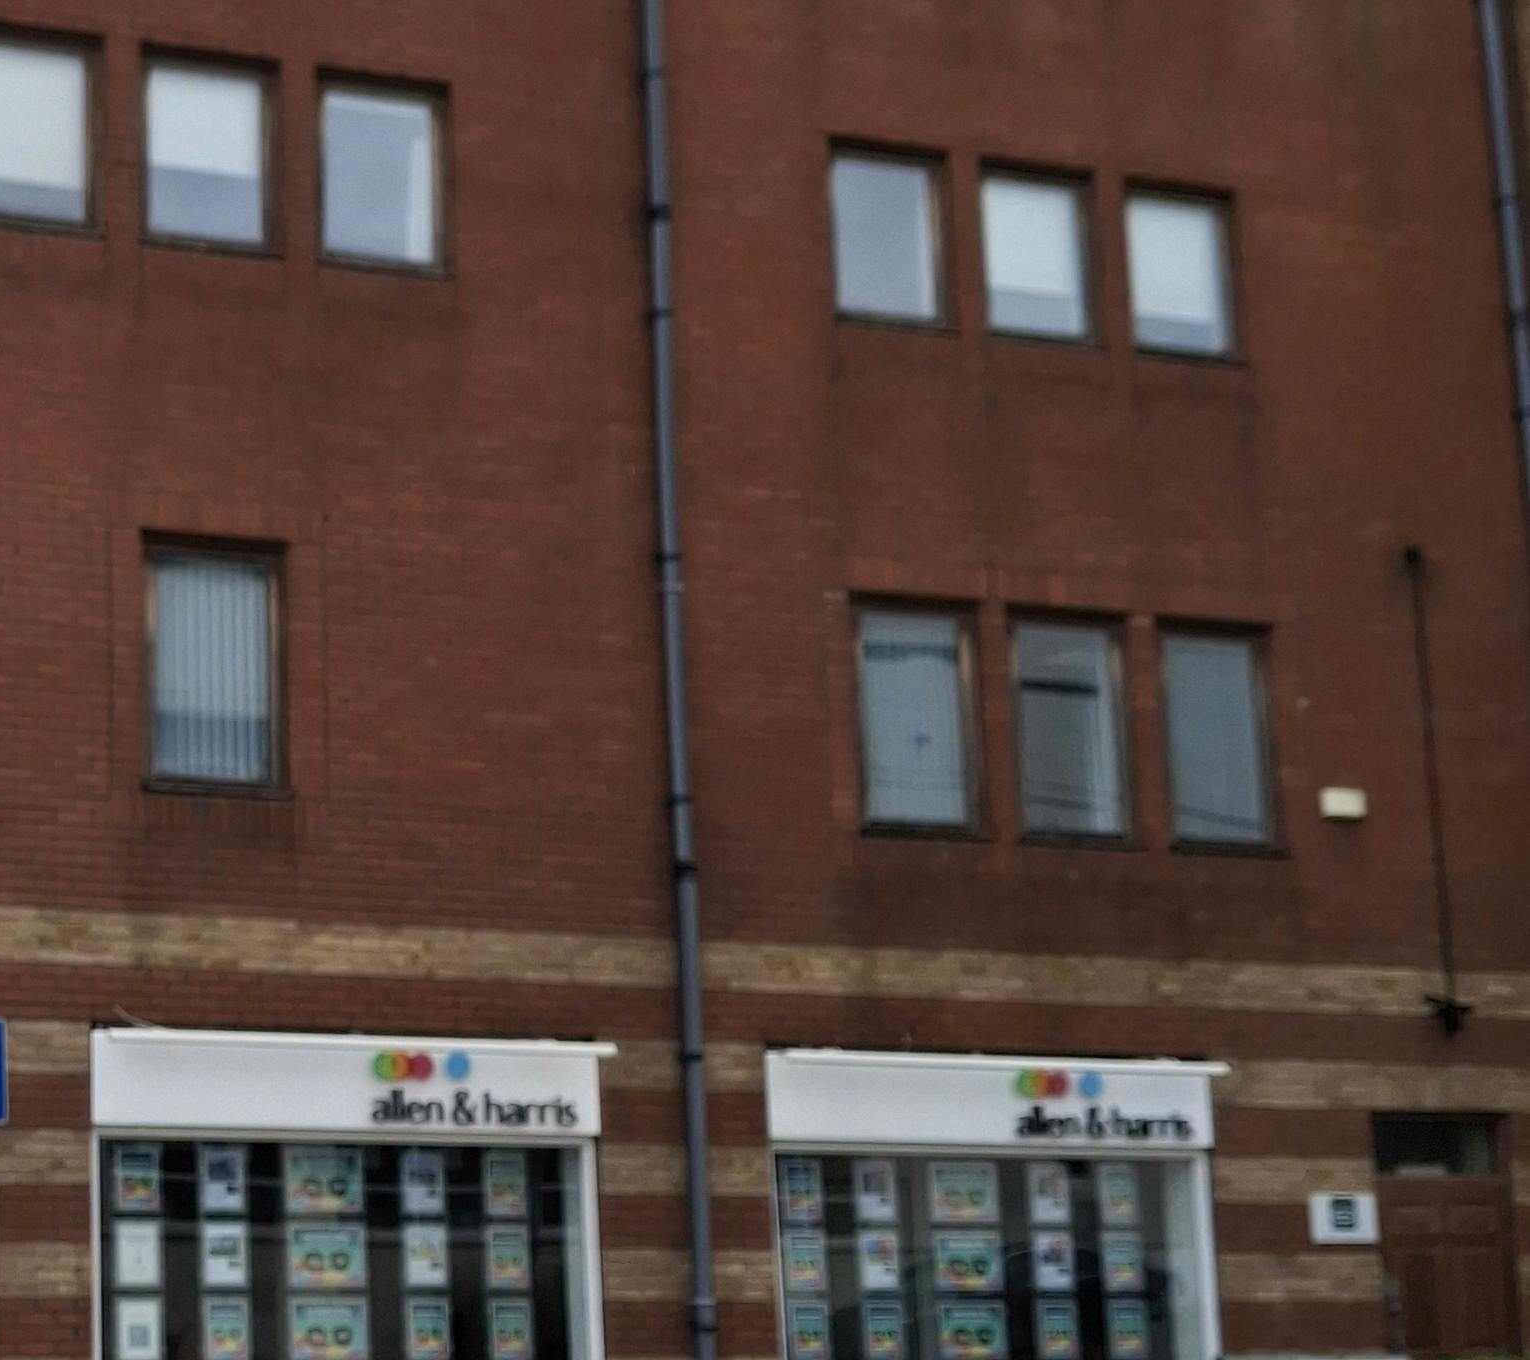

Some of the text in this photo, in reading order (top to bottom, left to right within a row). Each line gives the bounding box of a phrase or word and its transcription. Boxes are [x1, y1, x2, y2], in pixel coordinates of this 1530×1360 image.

[372, 1088, 579, 1127] allen & harris
[1016, 1105, 1083, 1138] allen
